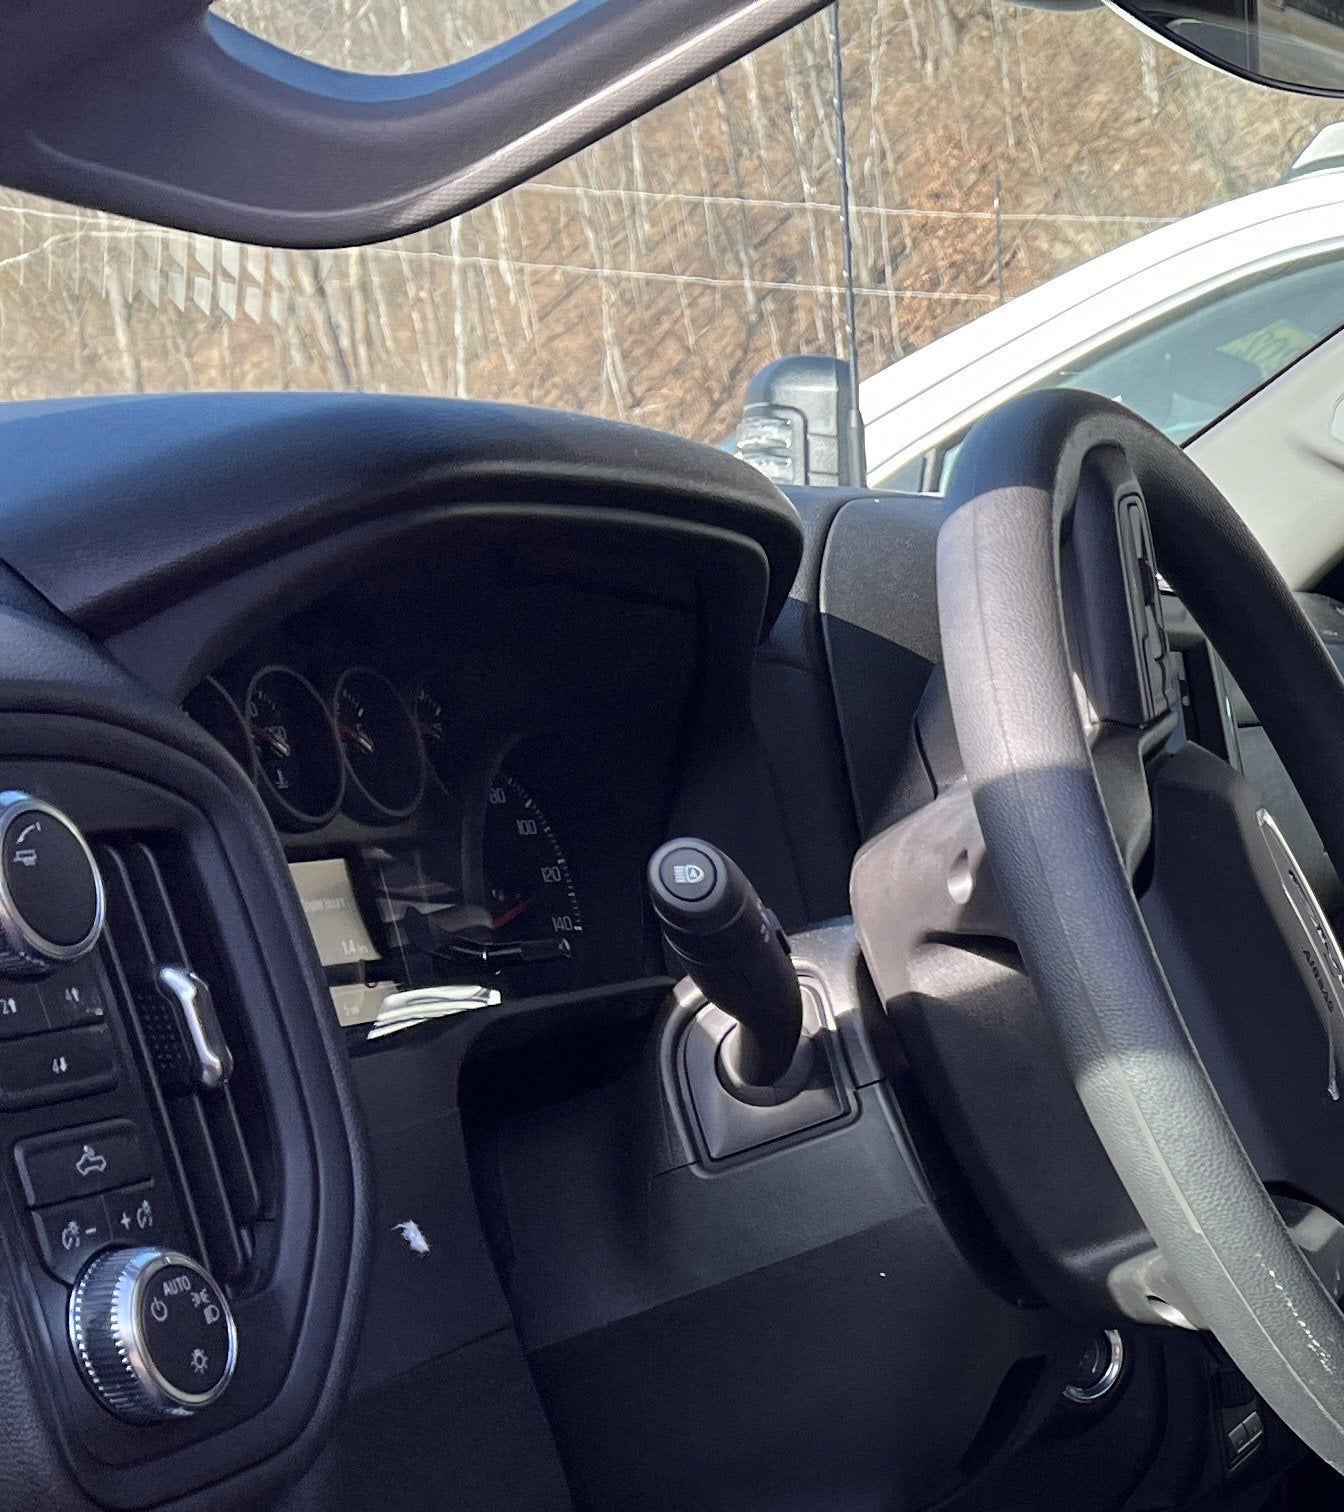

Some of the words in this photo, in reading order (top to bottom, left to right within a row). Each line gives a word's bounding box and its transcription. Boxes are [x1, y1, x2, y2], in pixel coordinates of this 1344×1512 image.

[541, 866, 562, 883] 120
[552, 916, 574, 932] 140
[162, 1275, 192, 1297] AUTO
